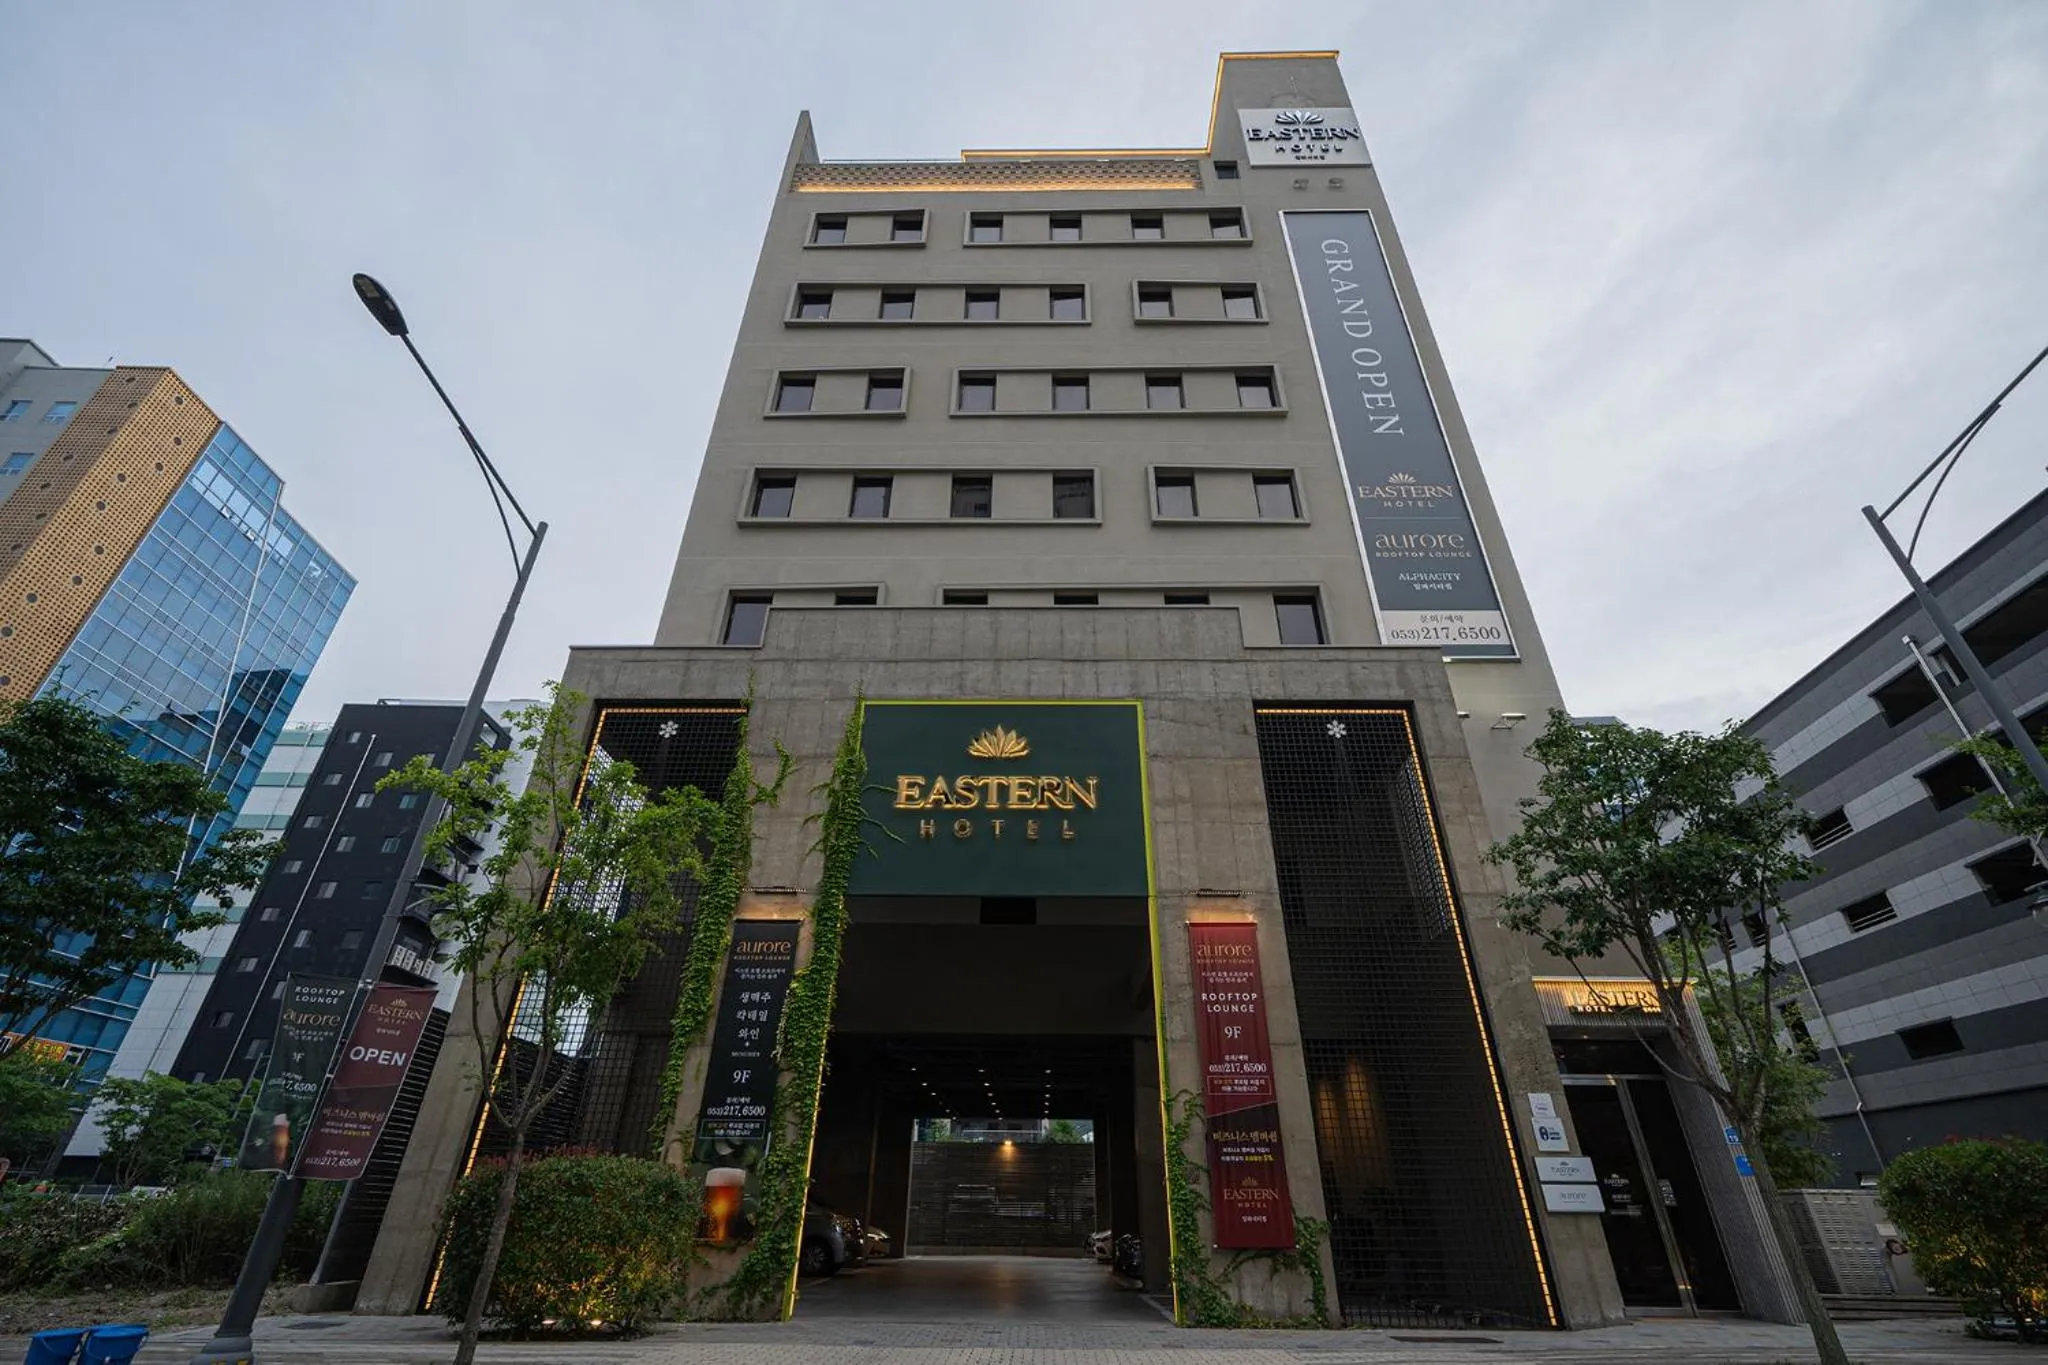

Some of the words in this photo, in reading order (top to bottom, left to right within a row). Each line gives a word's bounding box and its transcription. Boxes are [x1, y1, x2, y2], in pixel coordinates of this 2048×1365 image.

[1247, 128, 1359, 141] EASTERN
[1275, 144, 1343, 153] HOTEL
[1321, 239, 1373, 338] GRAND
[1352, 348, 1404, 437] OPEN
[1357, 485, 1454, 498] EASTERN
[1376, 533, 1464, 549] aurore
[1399, 572, 1461, 581] ALPHACITY
[895, 775, 1100, 809] EASTERN
[919, 818, 1076, 839] HOTEL
[736, 941, 791, 953] aurore
[1197, 944, 1252, 957] aurore
[295, 986, 346, 996] ROOFTOP
[1201, 993, 1257, 1001] ROOFTOP
[295, 994, 339, 1004] LOUNGE
[368, 1003, 424, 1020] EASTERN
[1207, 1004, 1255, 1012] LOUNGE
[1224, 1026, 1242, 1039] 9F
[350, 1046, 406, 1066] OPEN
[733, 1070, 751, 1083] 9F
[1224, 1188, 1280, 1200] EASTERN
